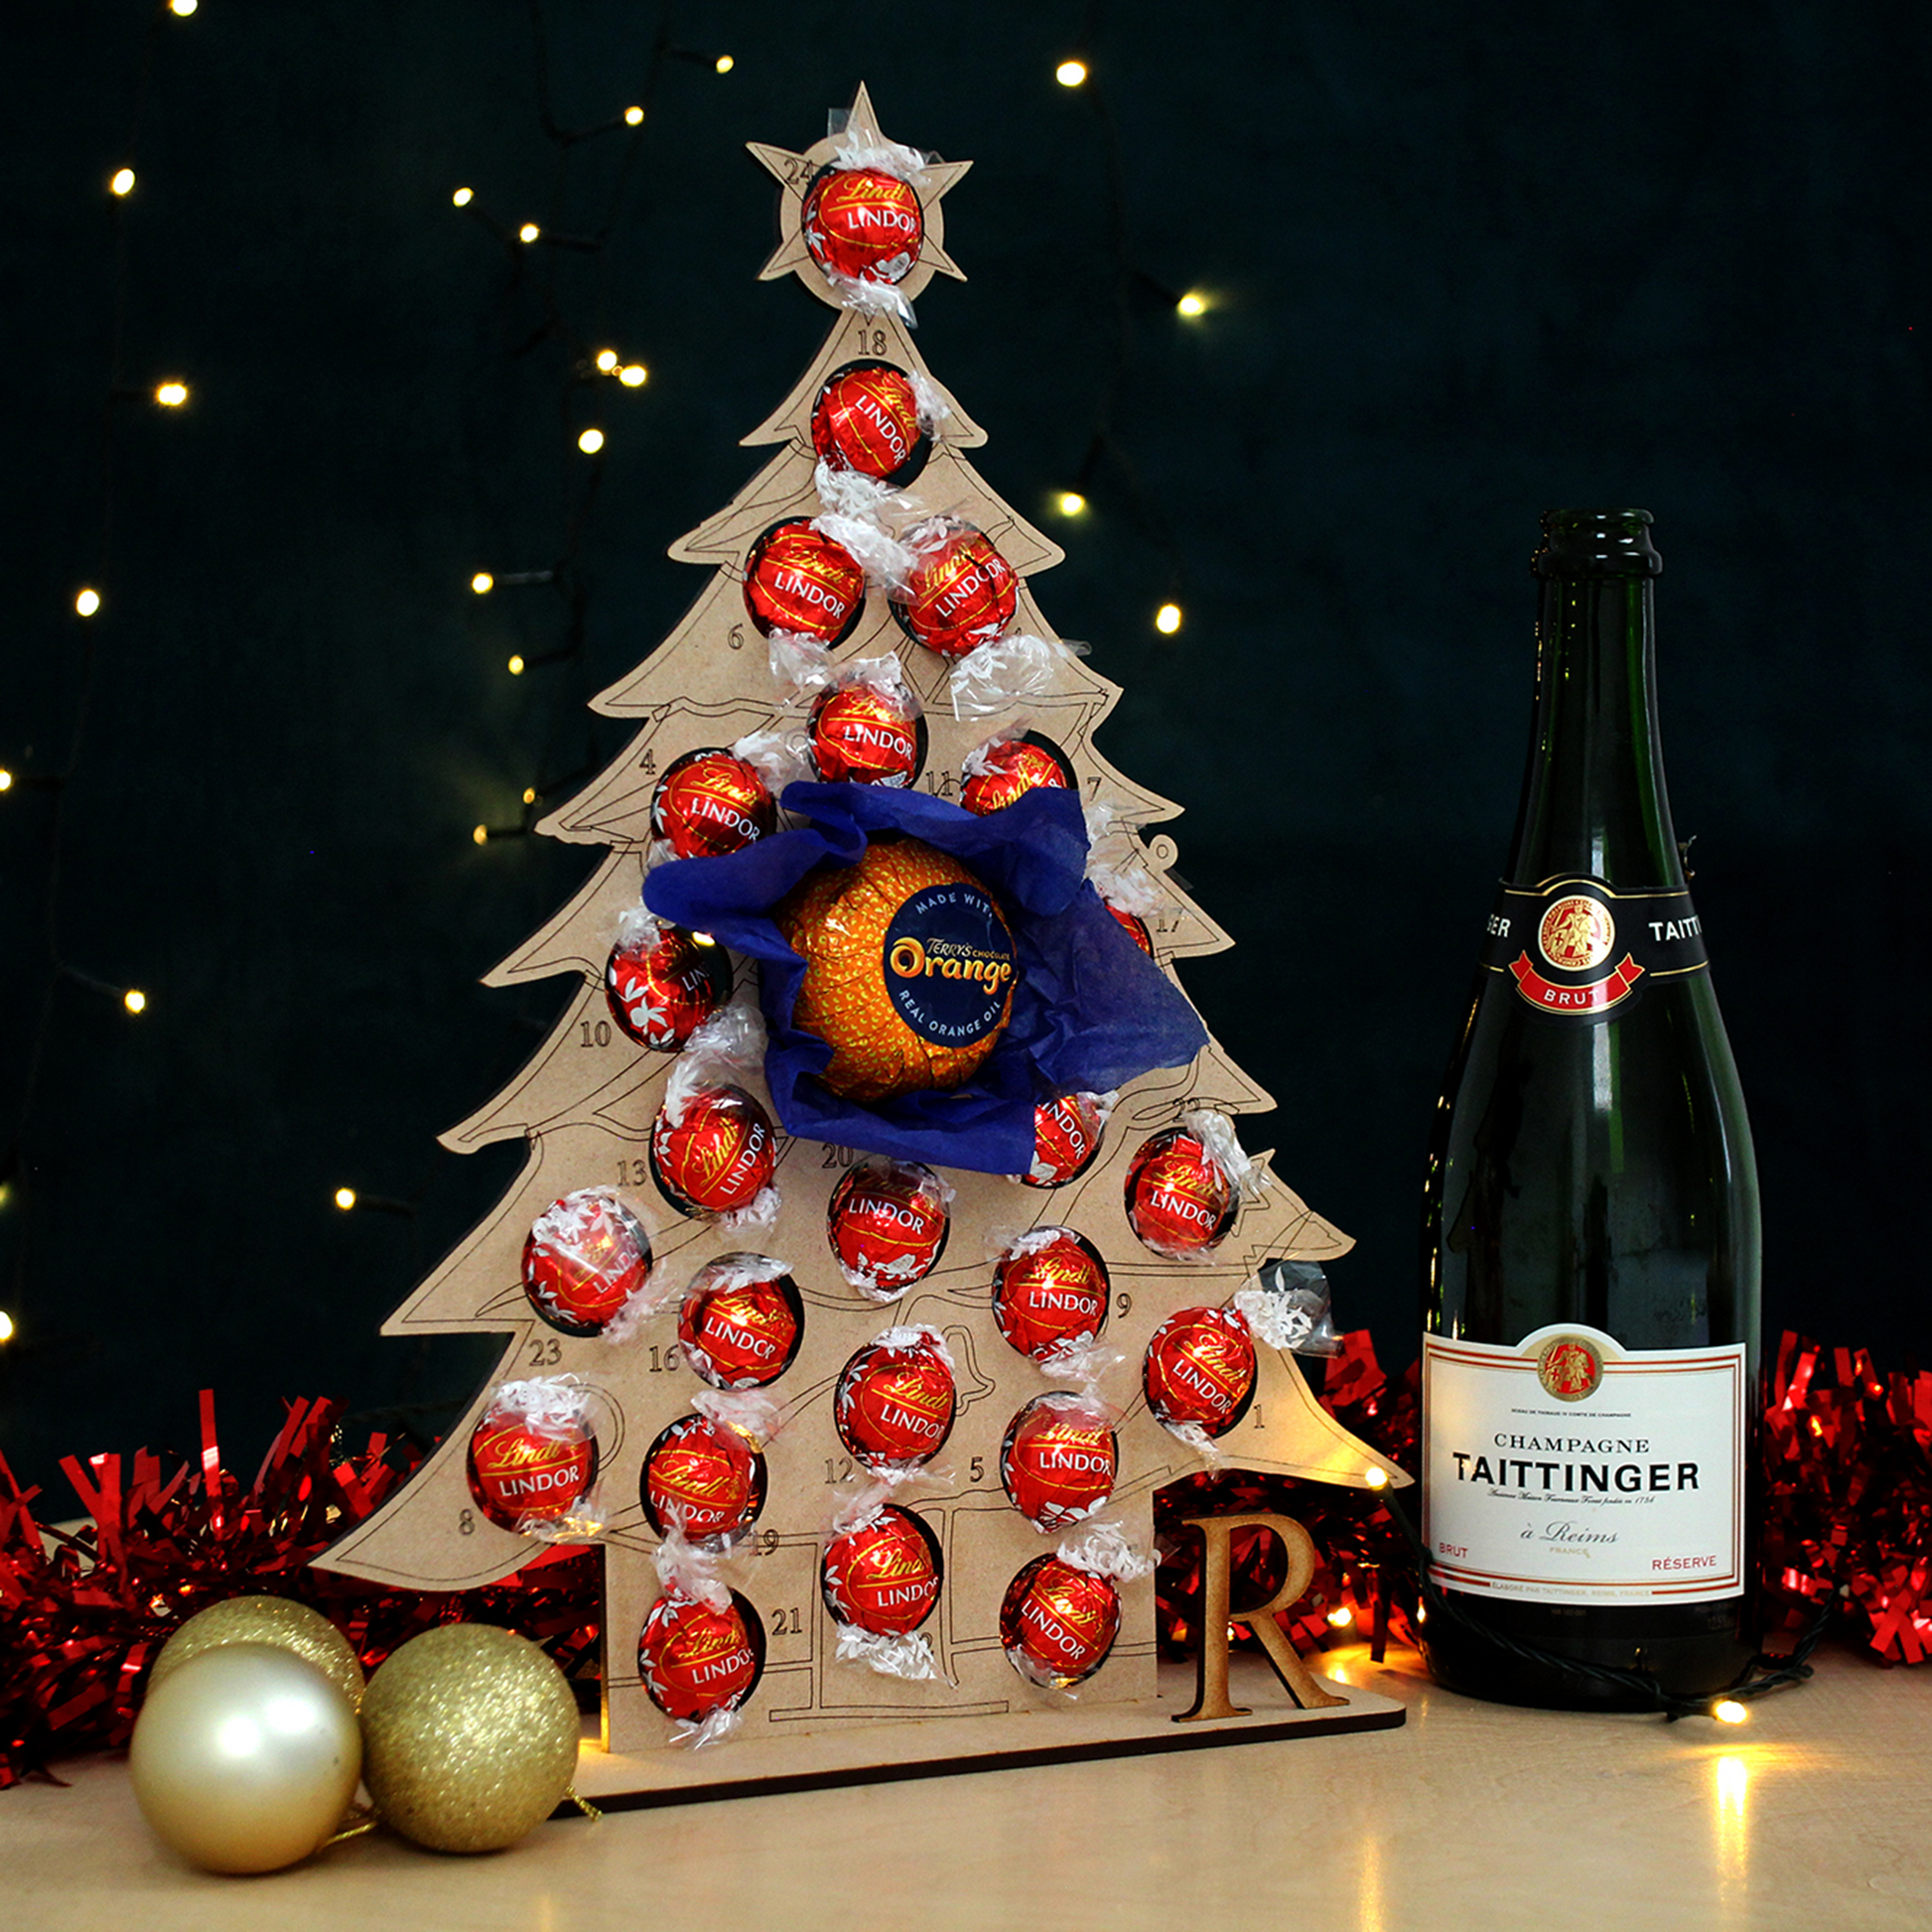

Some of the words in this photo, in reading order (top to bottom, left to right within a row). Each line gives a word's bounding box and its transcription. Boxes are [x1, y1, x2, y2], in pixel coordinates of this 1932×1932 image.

[783, 159, 814, 185] 24
[836, 177, 907, 202] Lindt
[858, 330, 887, 355] 18
[855, 395, 906, 465] LINDOR
[778, 543, 845, 584] Lindt
[773, 572, 846, 619] LINDOR
[728, 623, 744, 650] 6
[844, 725, 912, 760] LINDOR
[639, 749, 656, 775] 4
[690, 767, 759, 806] Lindt
[925, 770, 953, 796] 11
[1087, 777, 1101, 802] 7
[691, 796, 760, 843] LINDOR
[914, 892, 957, 914] MADE
[890, 936, 1012, 995] Orange
[1544, 989, 1599, 1006] BRUT
[898, 989, 924, 1024] REAL
[928, 1020, 982, 1036] ORANGE
[983, 1001, 1002, 1023] OIL
[580, 1021, 612, 1048] 10
[719, 1123, 766, 1194] LINDOR
[822, 1143, 854, 1169] 20
[617, 1159, 647, 1187] 13
[848, 1197, 925, 1235] LINDOR
[1150, 1190, 1217, 1230] LINDOR
[1023, 1257, 1091, 1285] Lindt
[1029, 1291, 1099, 1317] LINDOR
[1116, 1293, 1132, 1318] 9
[529, 1338, 563, 1366] 23
[648, 1344, 680, 1373] 16
[1172, 1358, 1233, 1415] LINDOR
[1253, 1404, 1265, 1430] 1
[486, 1438, 561, 1467] Lindt
[1494, 1433, 1649, 1453] CHAMPAGNE
[499, 1465, 579, 1497] LINDOR
[824, 1457, 854, 1484] 12
[969, 1455, 985, 1482] 5
[1452, 1451, 1700, 1493] TAITTINGER
[649, 1489, 726, 1524] LINDOR
[459, 1508, 475, 1535] 8
[1520, 1523, 1534, 1540] à
[1539, 1520, 1619, 1544] Reims
[748, 1529, 780, 1557] 19
[1440, 1542, 1468, 1558] BRUT
[1652, 1555, 1717, 1571] RÉSERVE
[771, 1606, 803, 1636] 21
[1021, 1598, 1086, 1661] LINDOR
[1172, 1513, 1350, 1723] R
